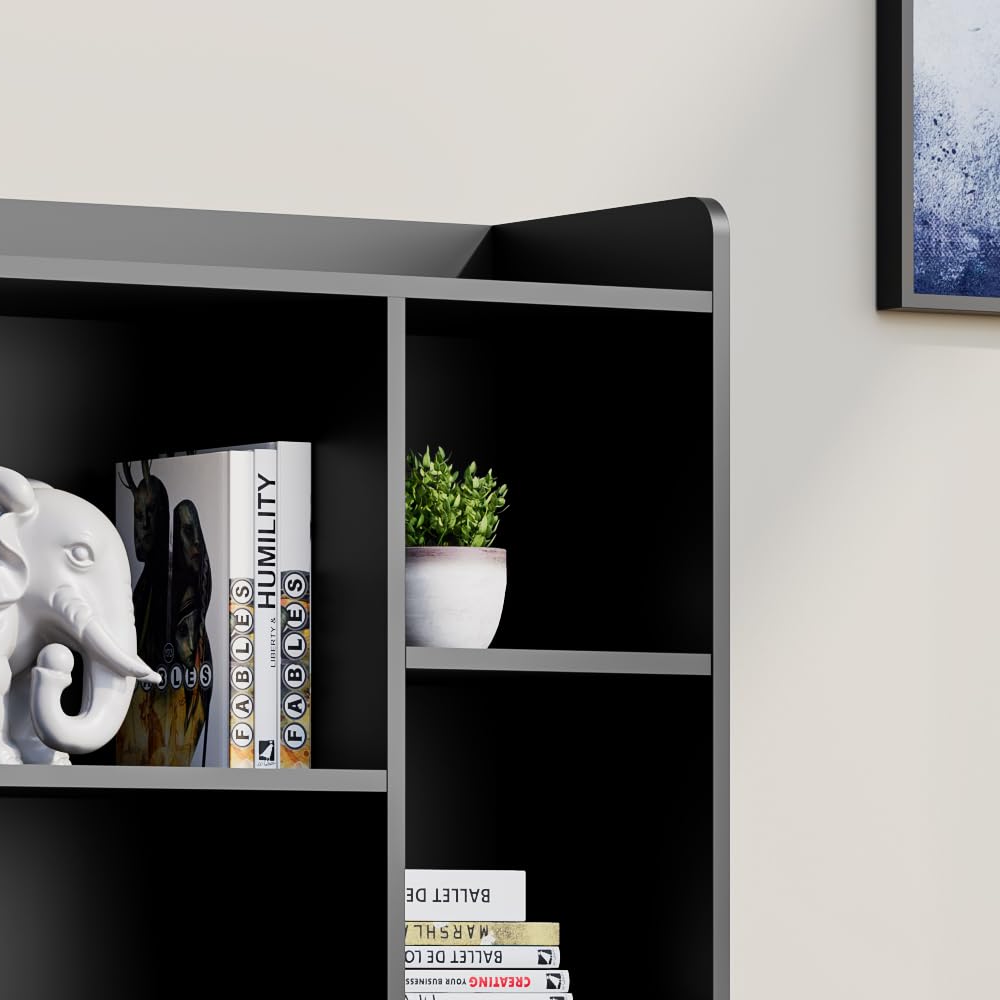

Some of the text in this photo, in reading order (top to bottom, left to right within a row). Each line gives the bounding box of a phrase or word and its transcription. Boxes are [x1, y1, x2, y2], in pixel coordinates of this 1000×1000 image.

[257, 473, 276, 609] HUMILITY
[233, 580, 252, 744] FABLES
[286, 576, 305, 745] FABLES
[406, 887, 491, 903] BALLET DE
[427, 950, 446, 963] DE
[450, 950, 503, 964] BALLET
[405, 977, 443, 985] BUSINESS
[468, 976, 531, 988] CREATING
